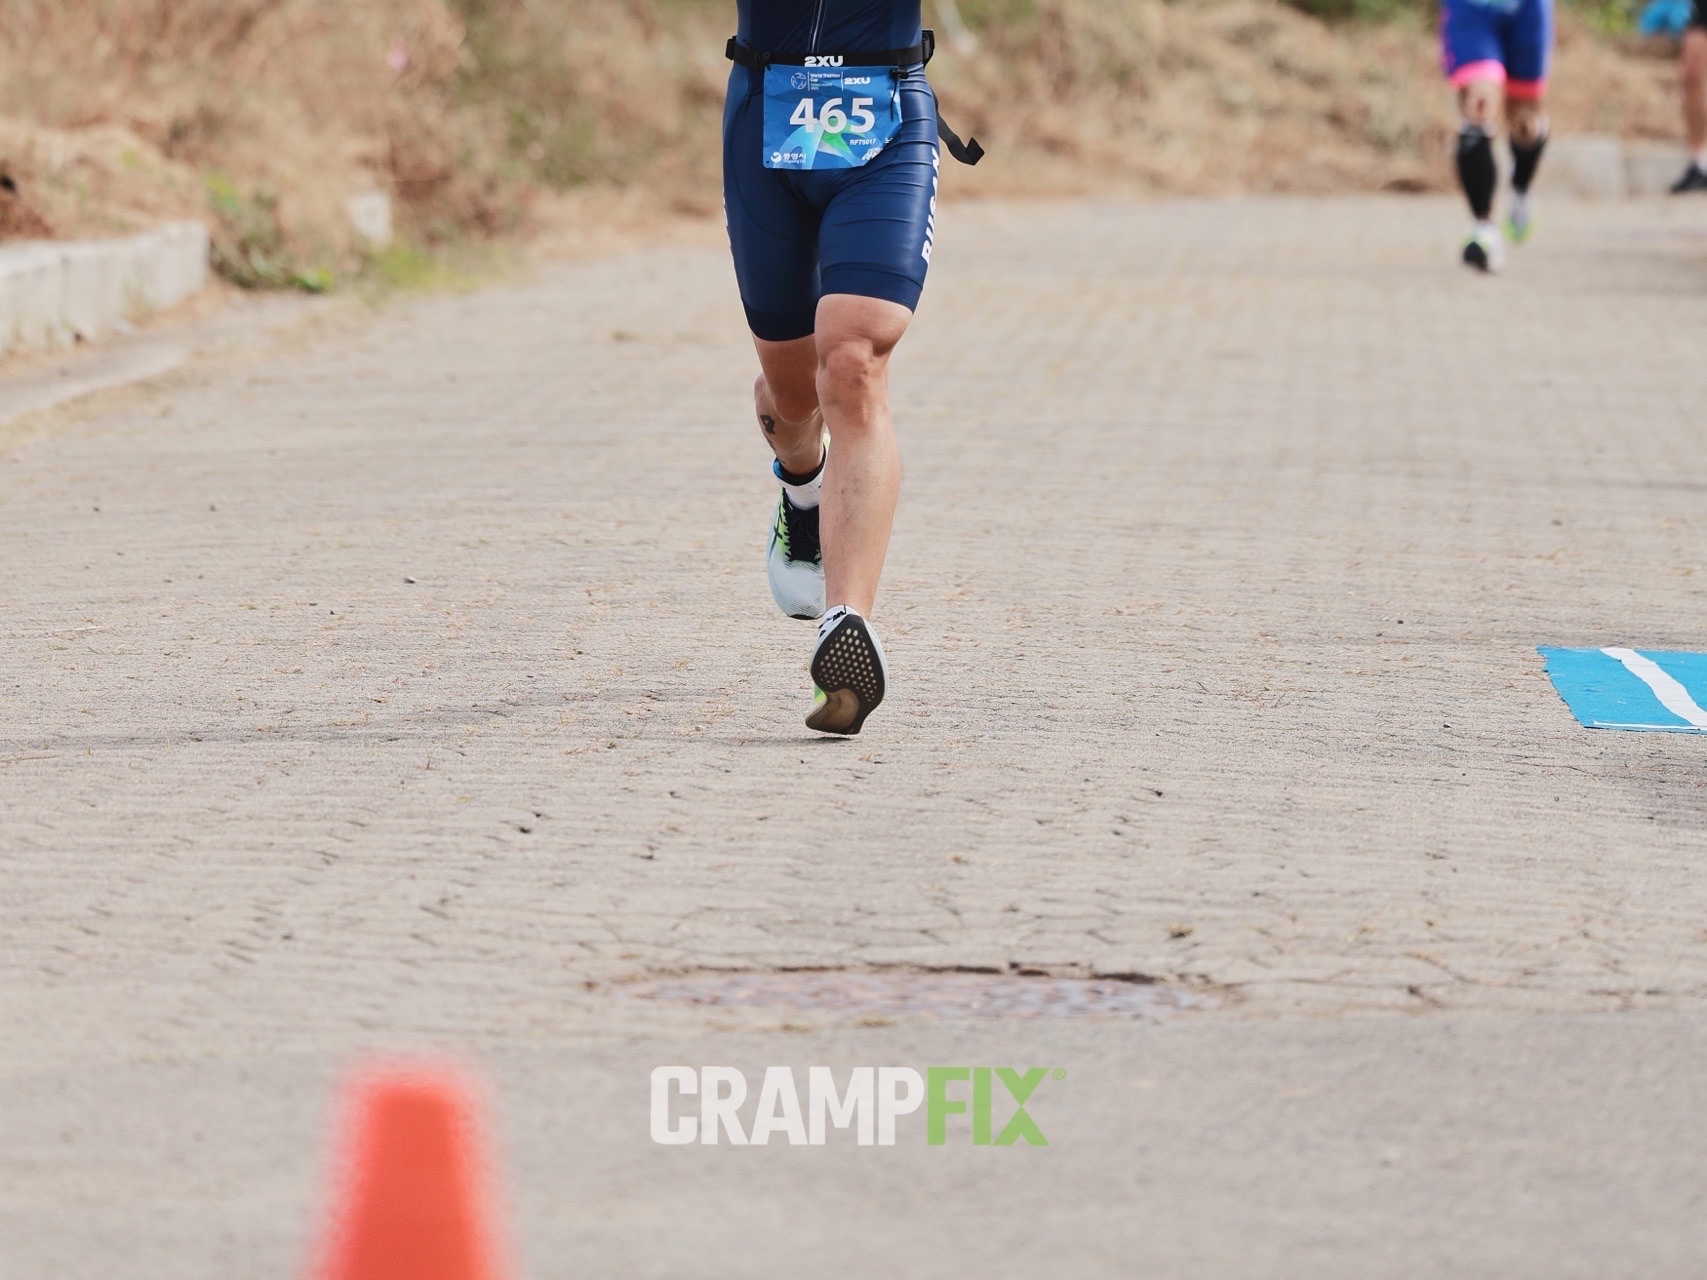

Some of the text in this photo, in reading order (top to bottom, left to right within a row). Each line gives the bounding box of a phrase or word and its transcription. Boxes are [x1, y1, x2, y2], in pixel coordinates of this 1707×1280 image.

[804, 55, 844, 67] 2XU
[844, 77, 871, 85] 2XU
[789, 97, 876, 134] 465
